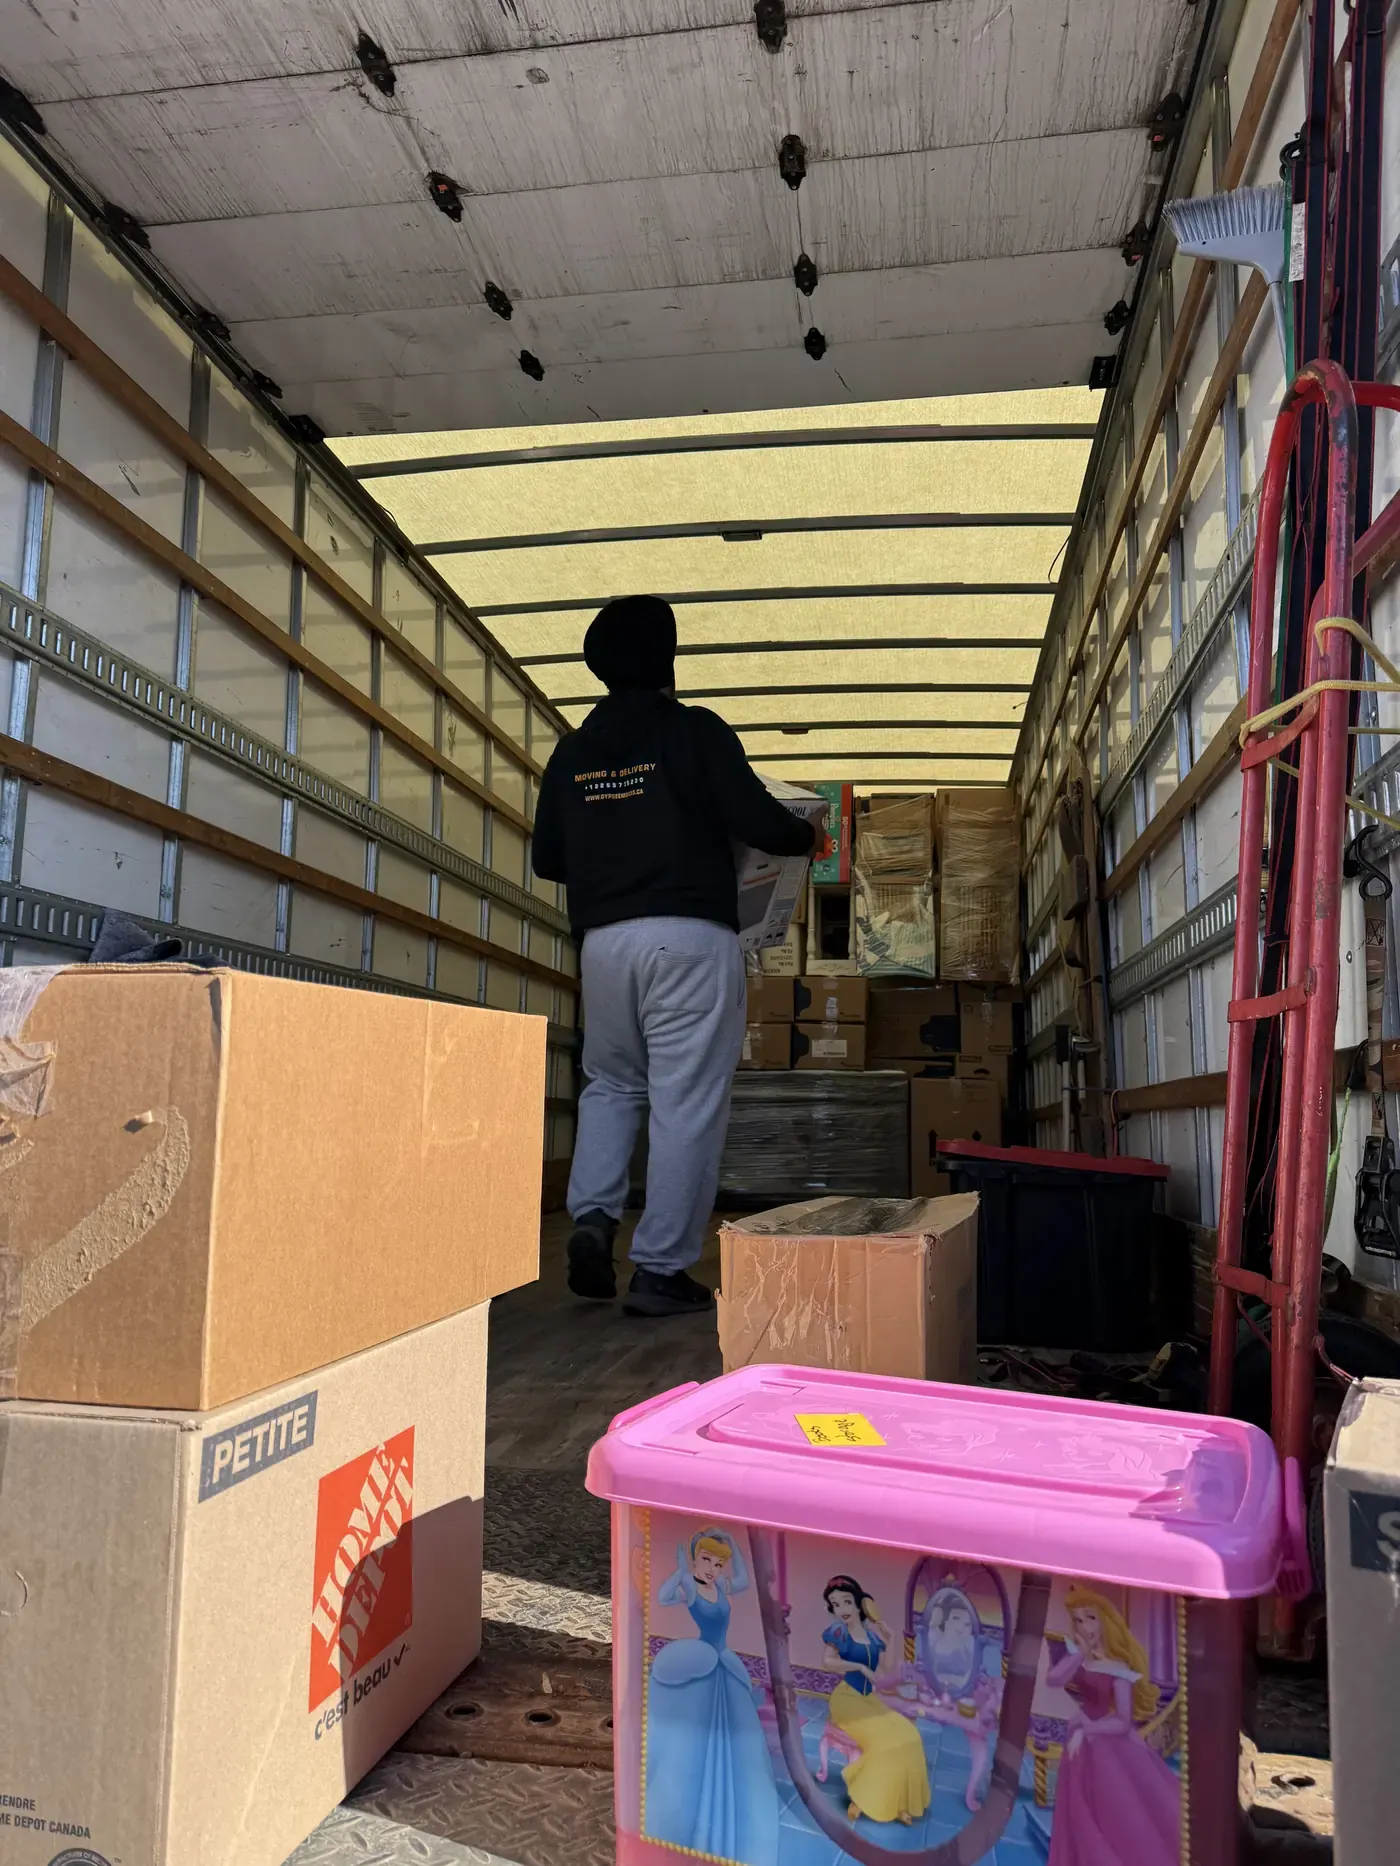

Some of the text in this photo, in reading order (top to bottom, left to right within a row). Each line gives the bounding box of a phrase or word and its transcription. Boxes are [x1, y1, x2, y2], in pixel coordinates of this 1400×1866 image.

[574, 770, 607, 782] MOVING
[619, 763, 656, 777] DELIVERY
[212, 1404, 308, 1485] PETITE
[311, 1442, 396, 1648] HOME
[328, 1456, 414, 1685] DEPOT
[314, 1658, 391, 1741] c'est beau
[14, 1815, 47, 1832] DEPOT
[49, 1820, 91, 1839] CANADA
